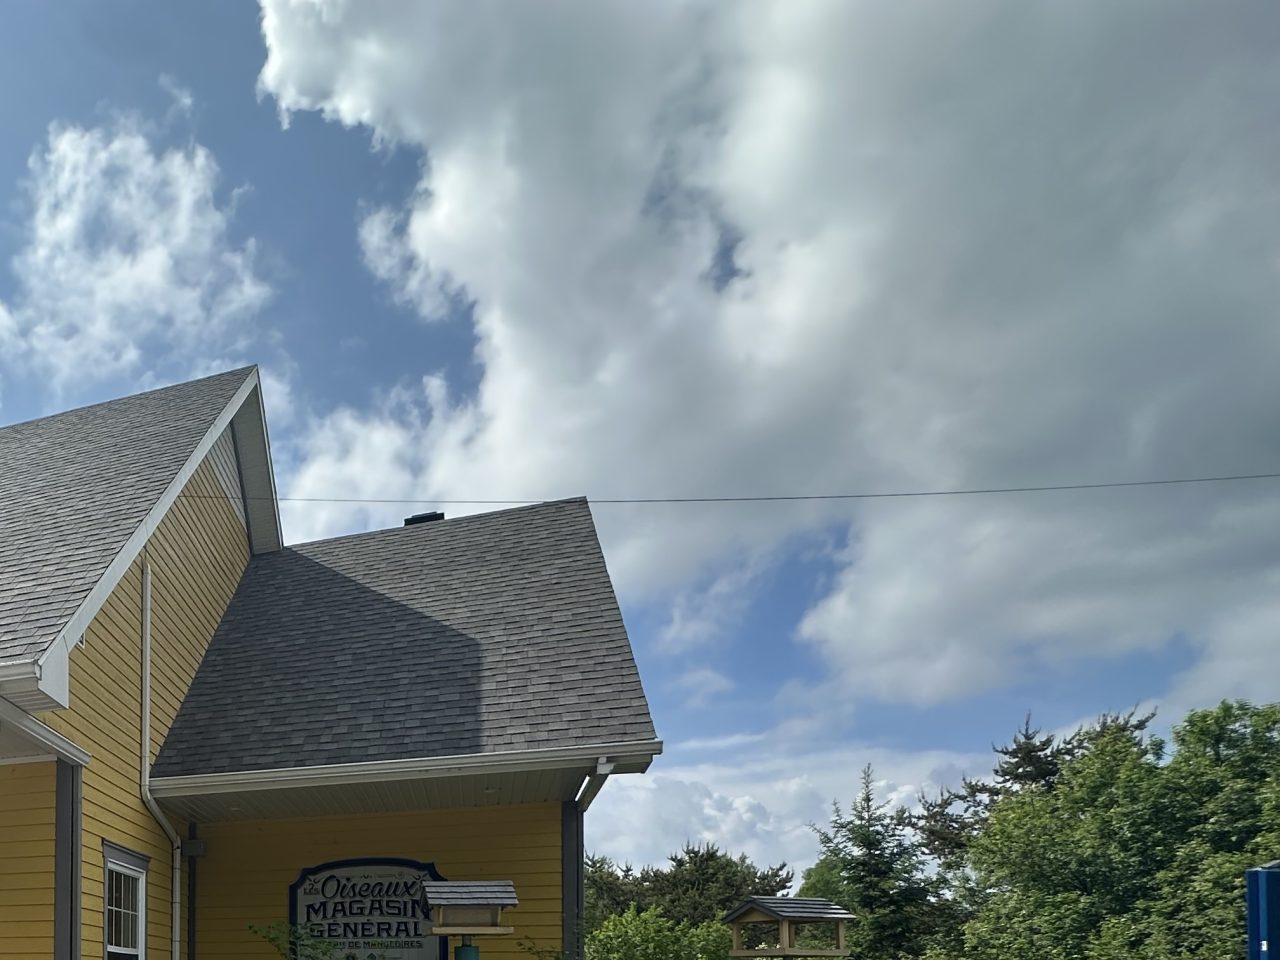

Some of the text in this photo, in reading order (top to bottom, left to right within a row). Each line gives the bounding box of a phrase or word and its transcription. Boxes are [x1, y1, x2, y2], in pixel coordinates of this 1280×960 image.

[321, 875, 417, 899] Oiseaux
[306, 899, 430, 923] MAGASIN
[311, 919, 423, 938] GÉNÉRAL
